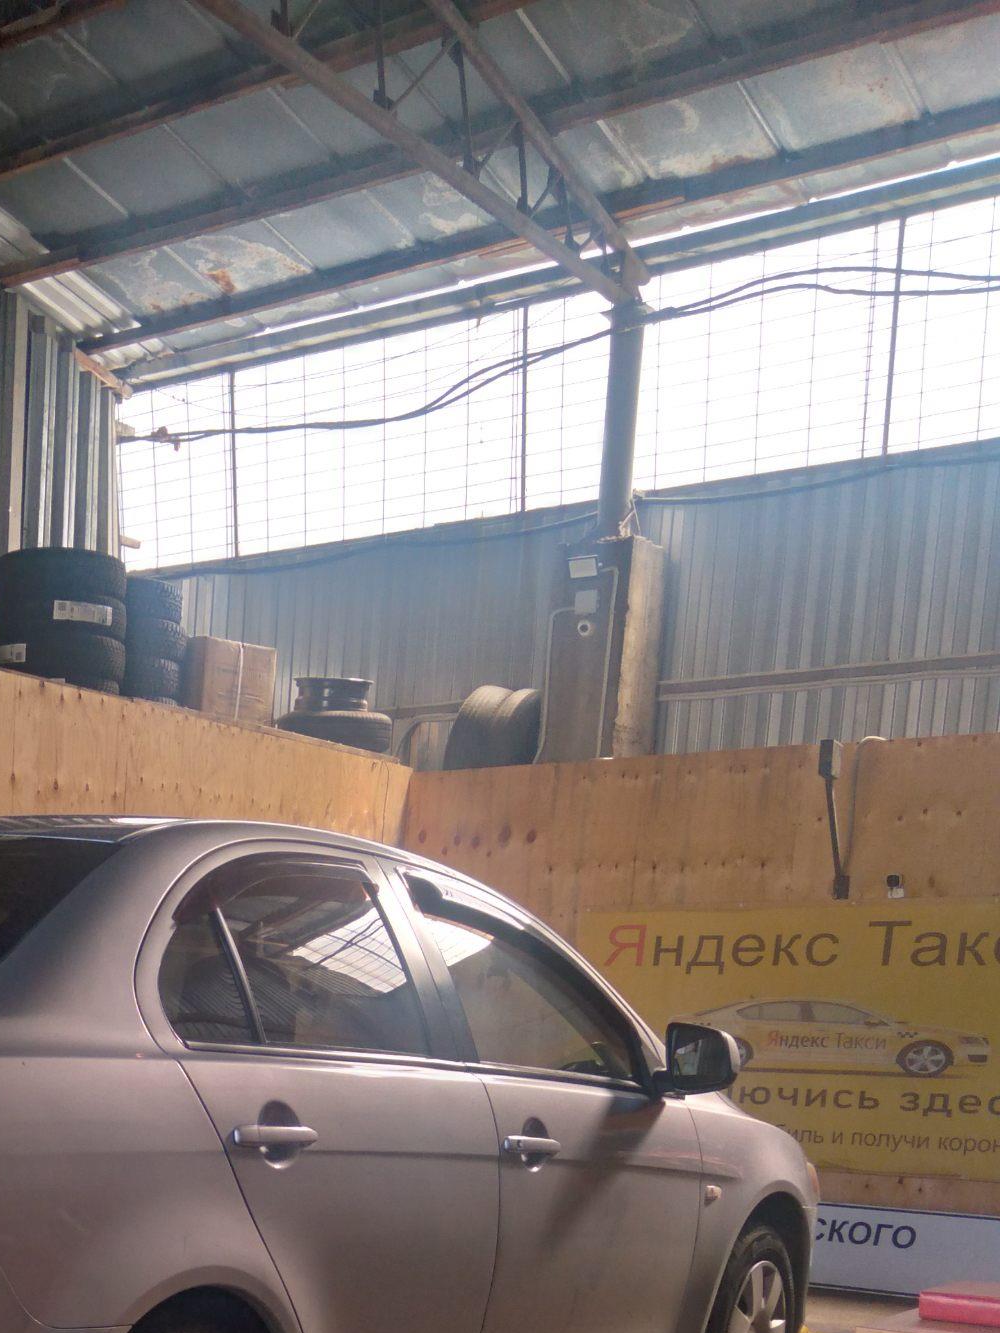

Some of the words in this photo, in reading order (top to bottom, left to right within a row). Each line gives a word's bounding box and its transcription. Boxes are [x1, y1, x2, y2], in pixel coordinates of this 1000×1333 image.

[604, 923, 840, 975] Яндекс
[868, 920, 1000, 967] Так
[767, 1030, 830, 1049] Яндекс
[834, 1032, 887, 1050] Такси
[728, 1085, 881, 1110] ючись
[832, 1130, 844, 1145] и
[851, 1131, 930, 1152] получи
